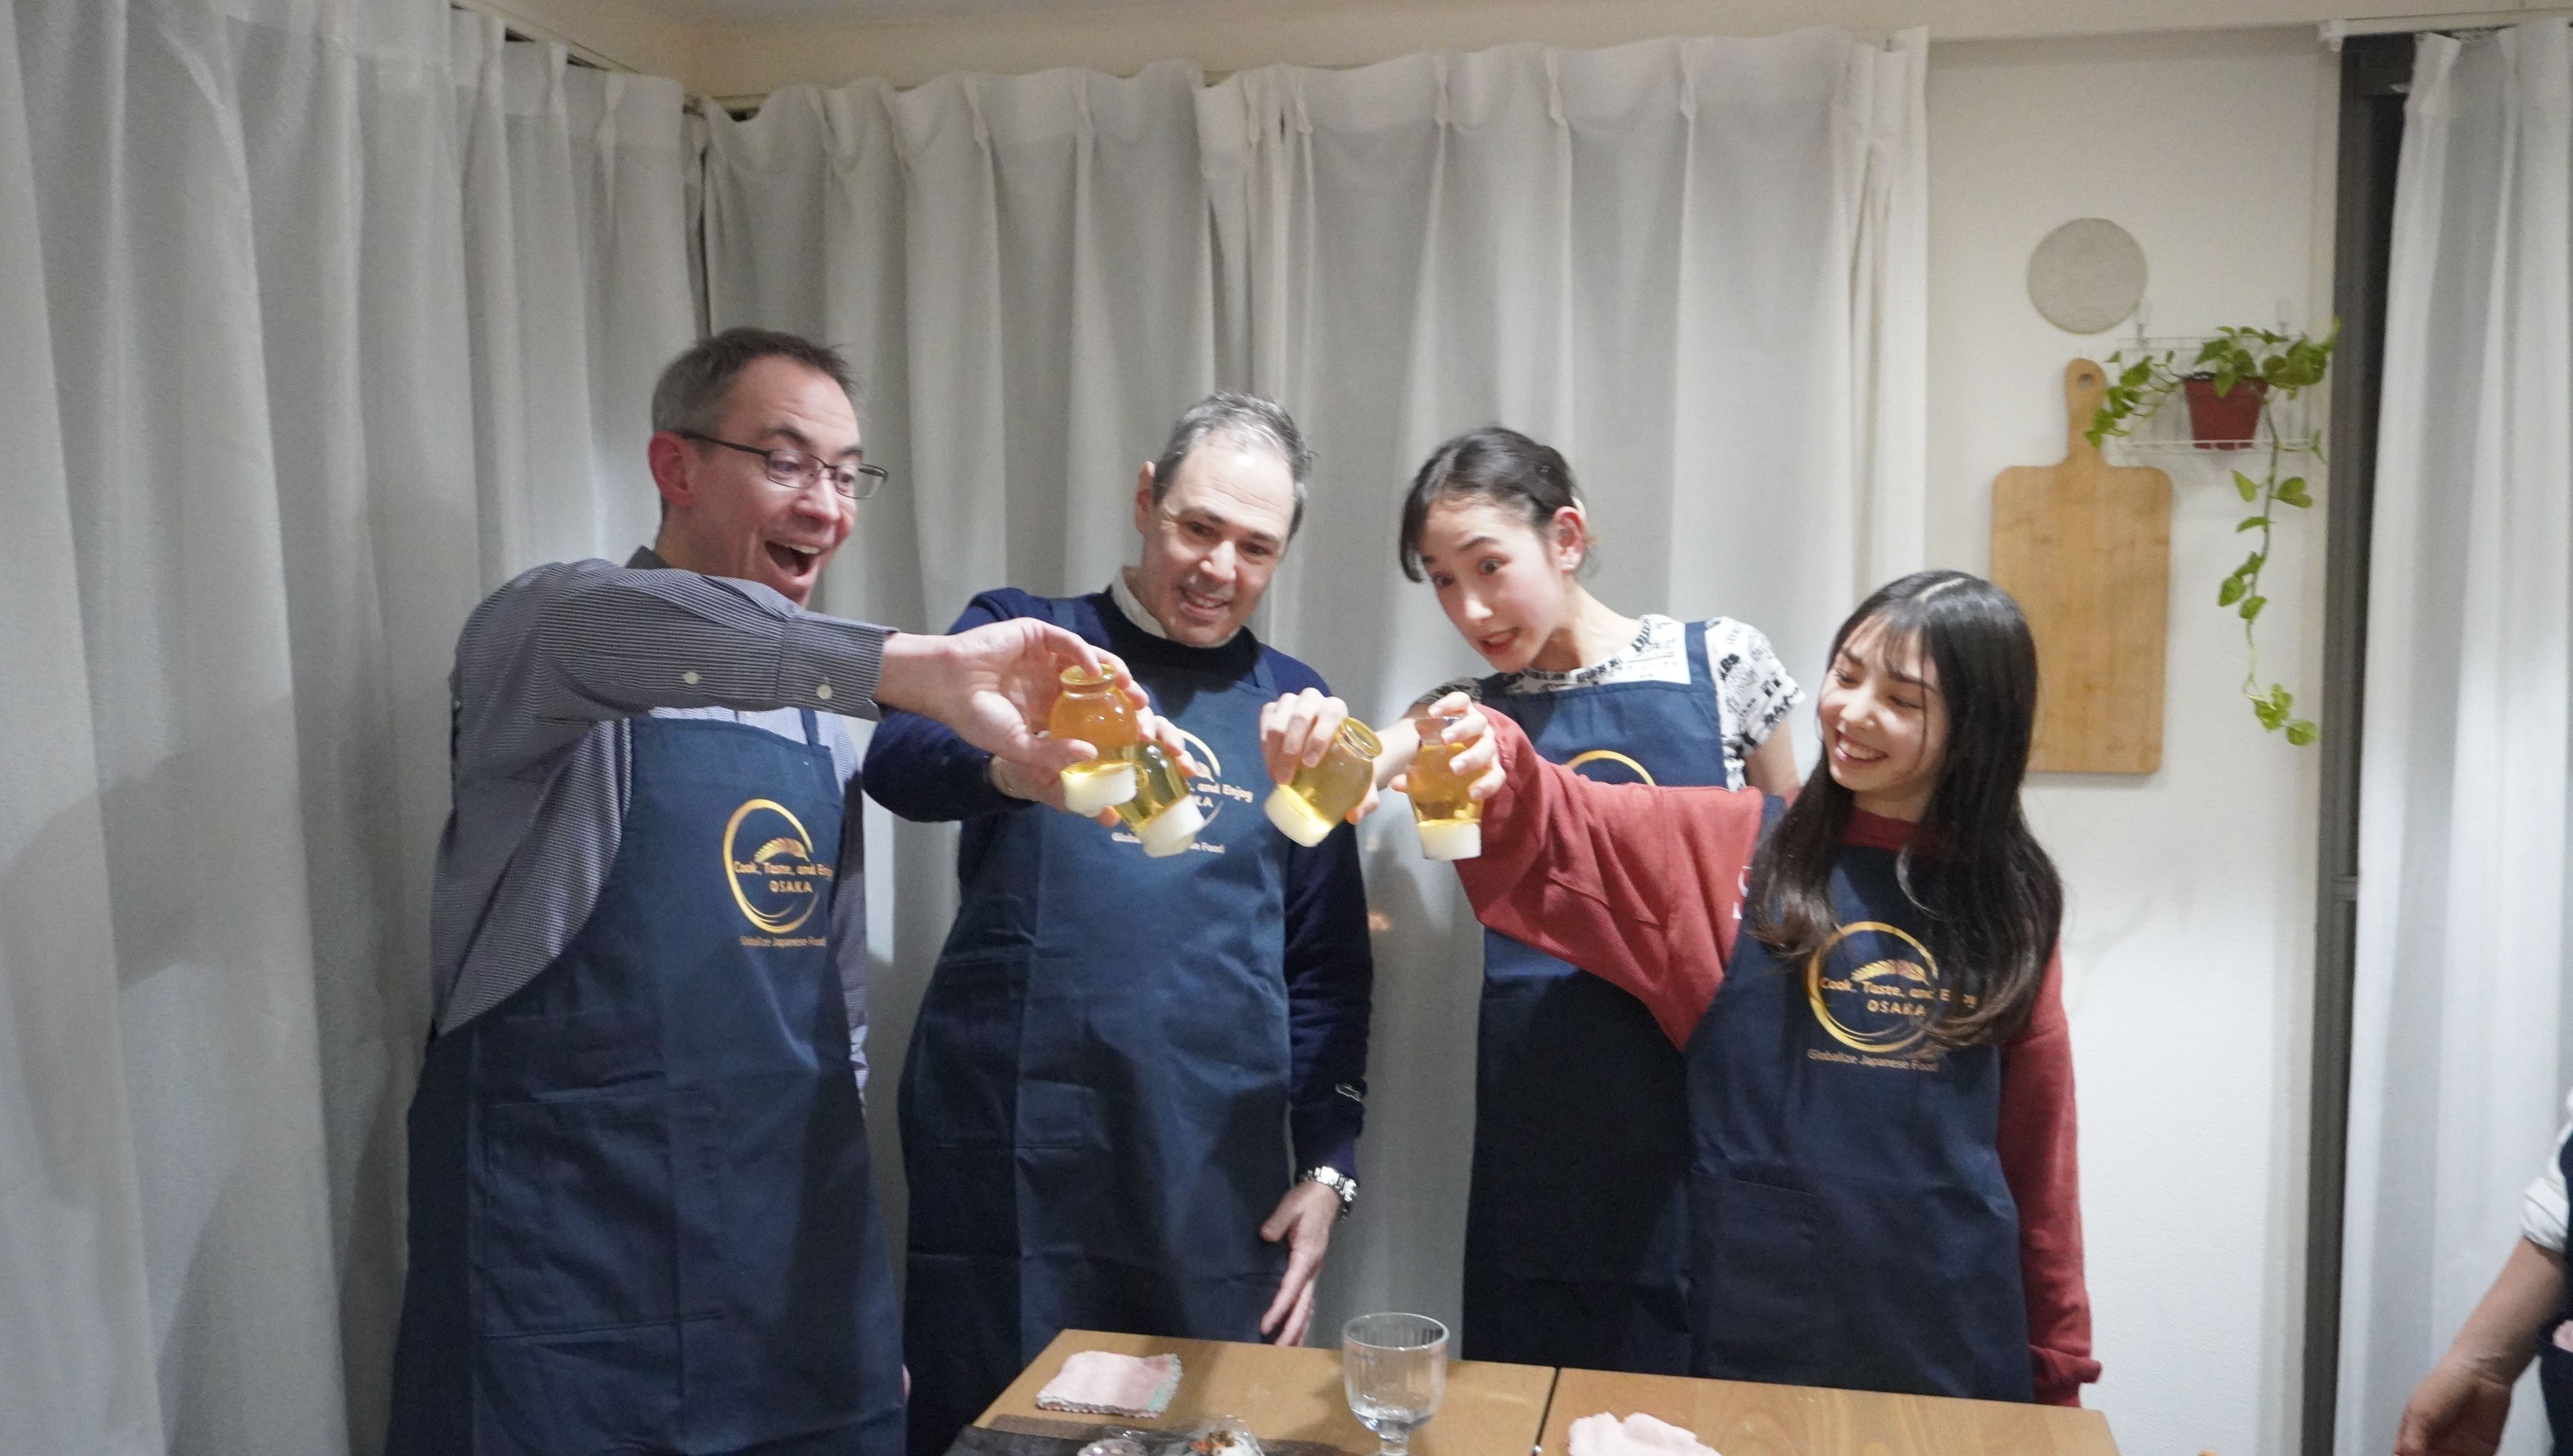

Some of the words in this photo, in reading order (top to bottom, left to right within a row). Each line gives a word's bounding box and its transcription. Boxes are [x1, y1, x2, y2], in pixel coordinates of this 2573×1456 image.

[1197, 783, 1220, 794] and
[1222, 784, 1253, 803] Enjoy
[796, 863, 817, 875] and
[769, 880, 814, 893] OSAKA
[1821, 977, 1857, 993] Cook,
[1861, 980, 1907, 999] Taste,
[1867, 999, 1927, 1017] OSAKA
